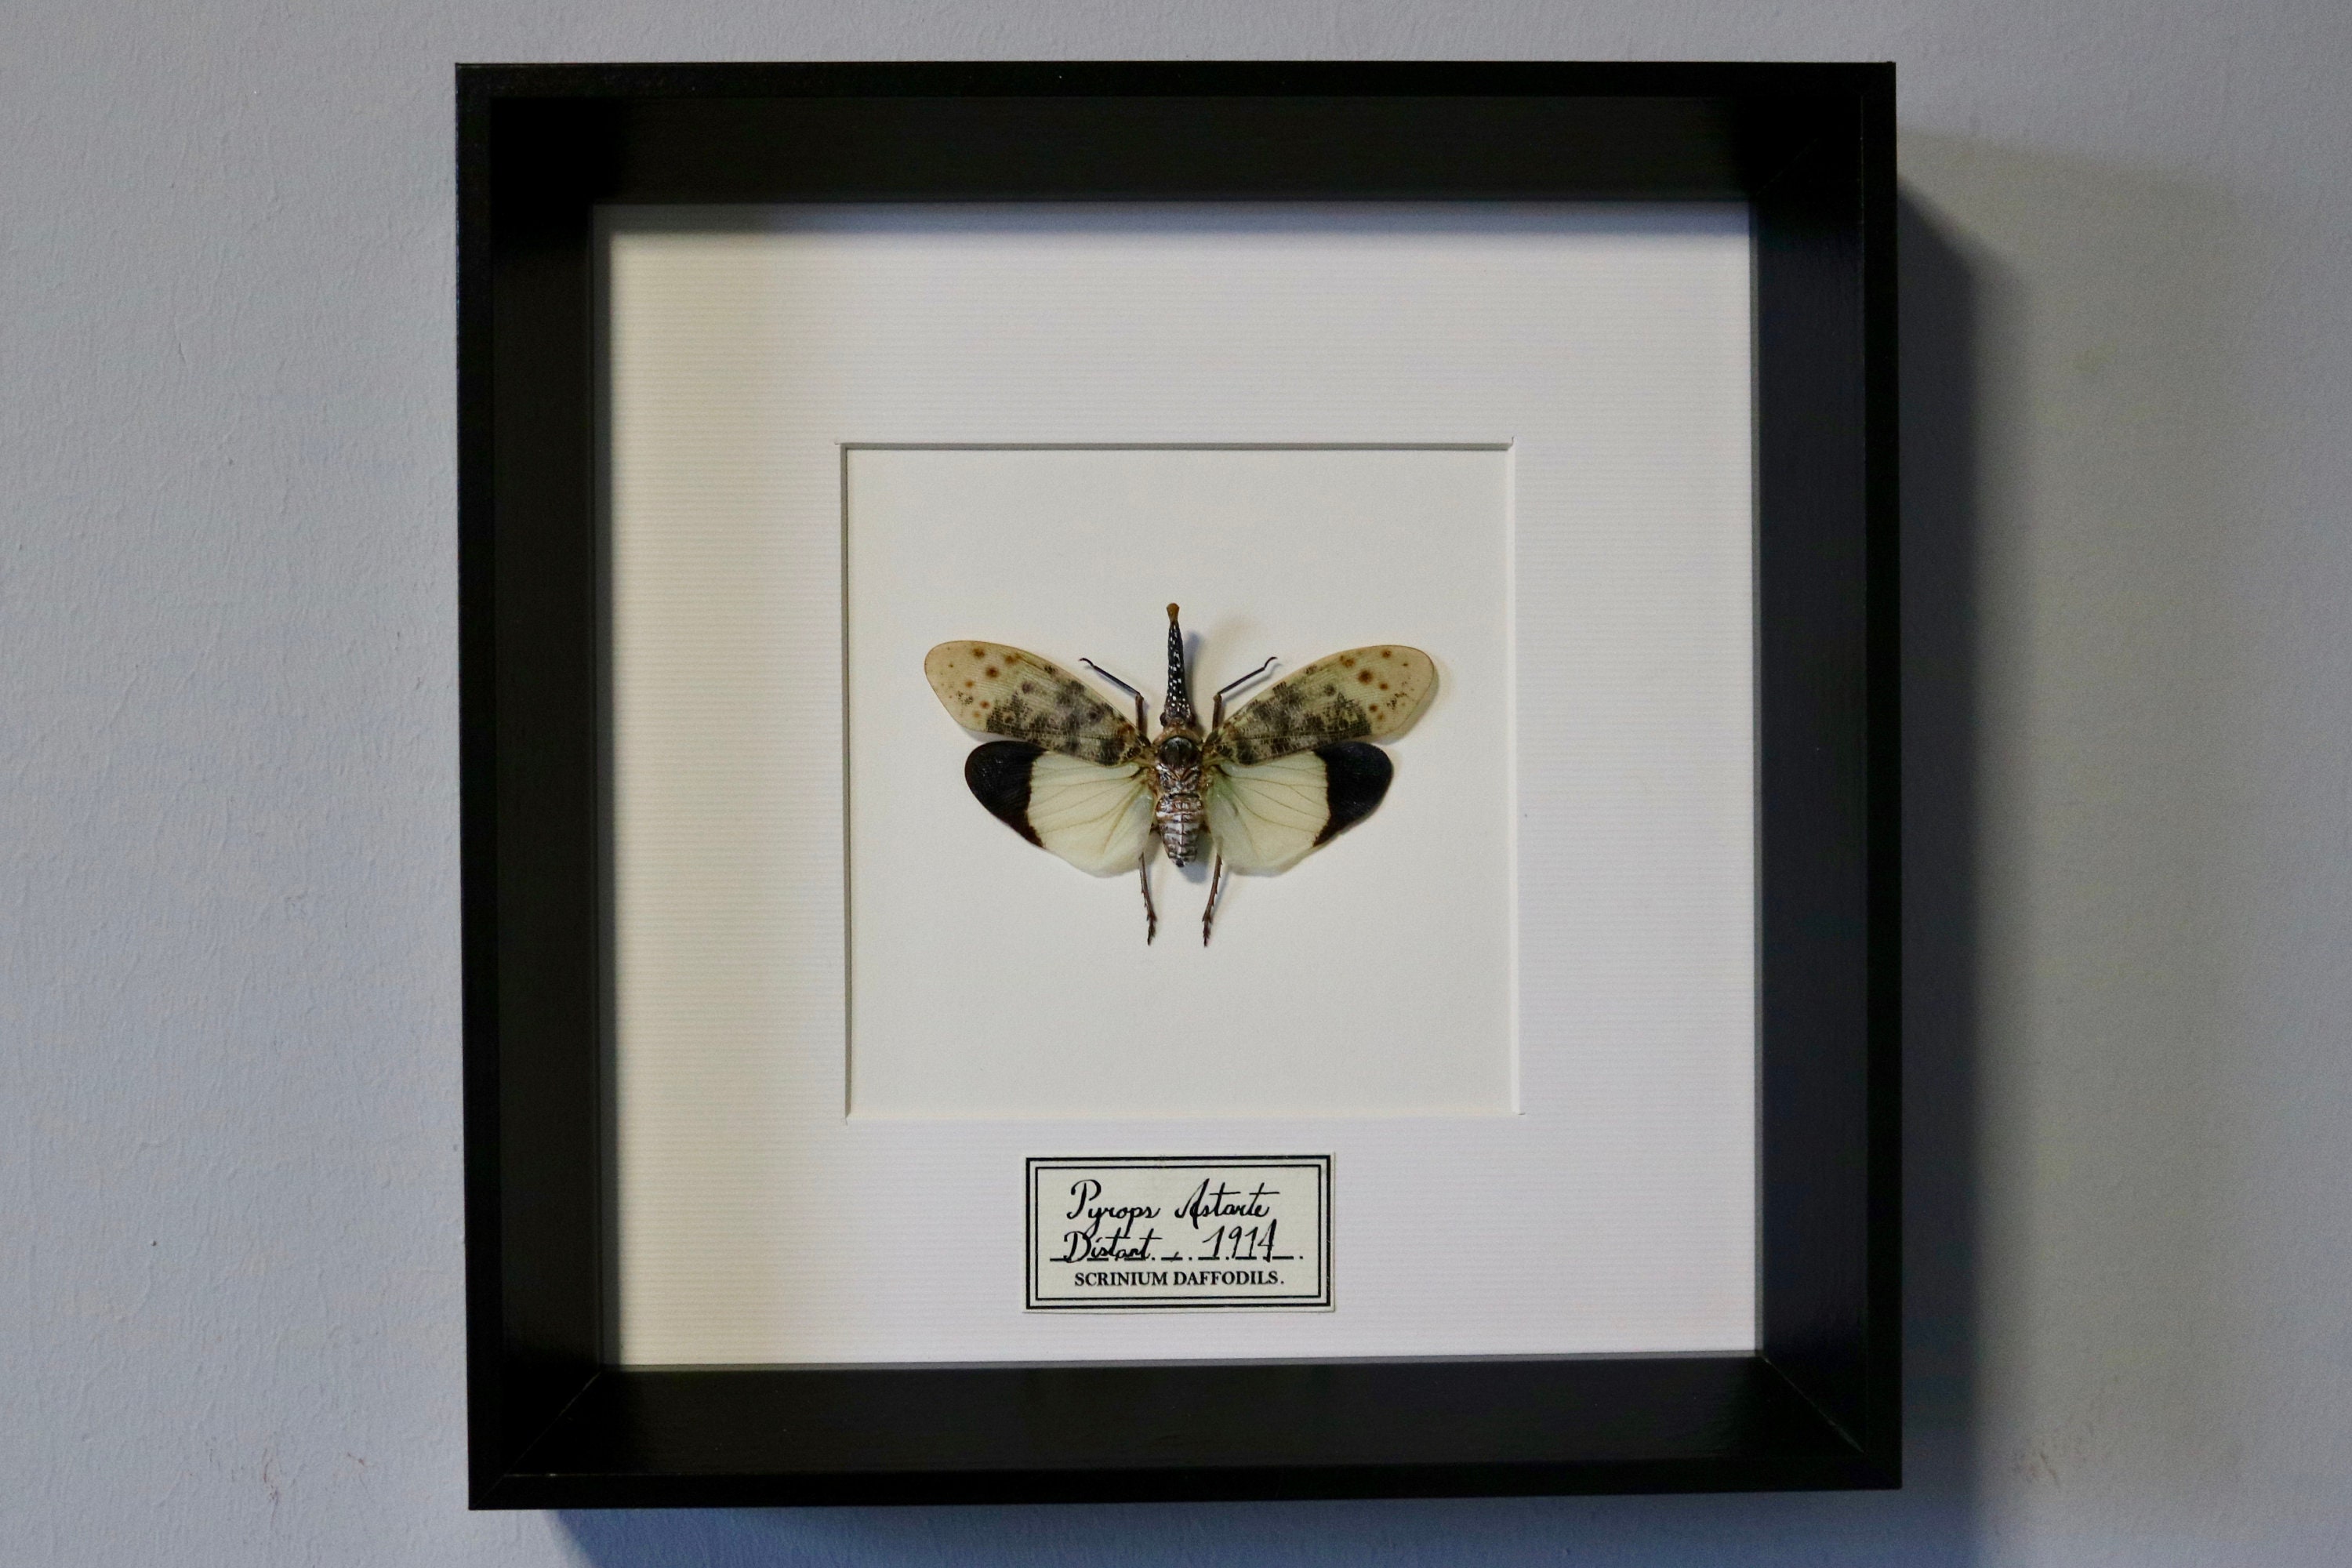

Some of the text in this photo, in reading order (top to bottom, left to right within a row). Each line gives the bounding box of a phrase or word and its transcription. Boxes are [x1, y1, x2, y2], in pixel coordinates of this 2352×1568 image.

[1066, 1178, 1280, 1240] Pyrops Astarte
[1201, 1218, 1277, 1263] 1914
[1074, 1270, 1285, 1287] SCRINIUM DAFFODILS.
